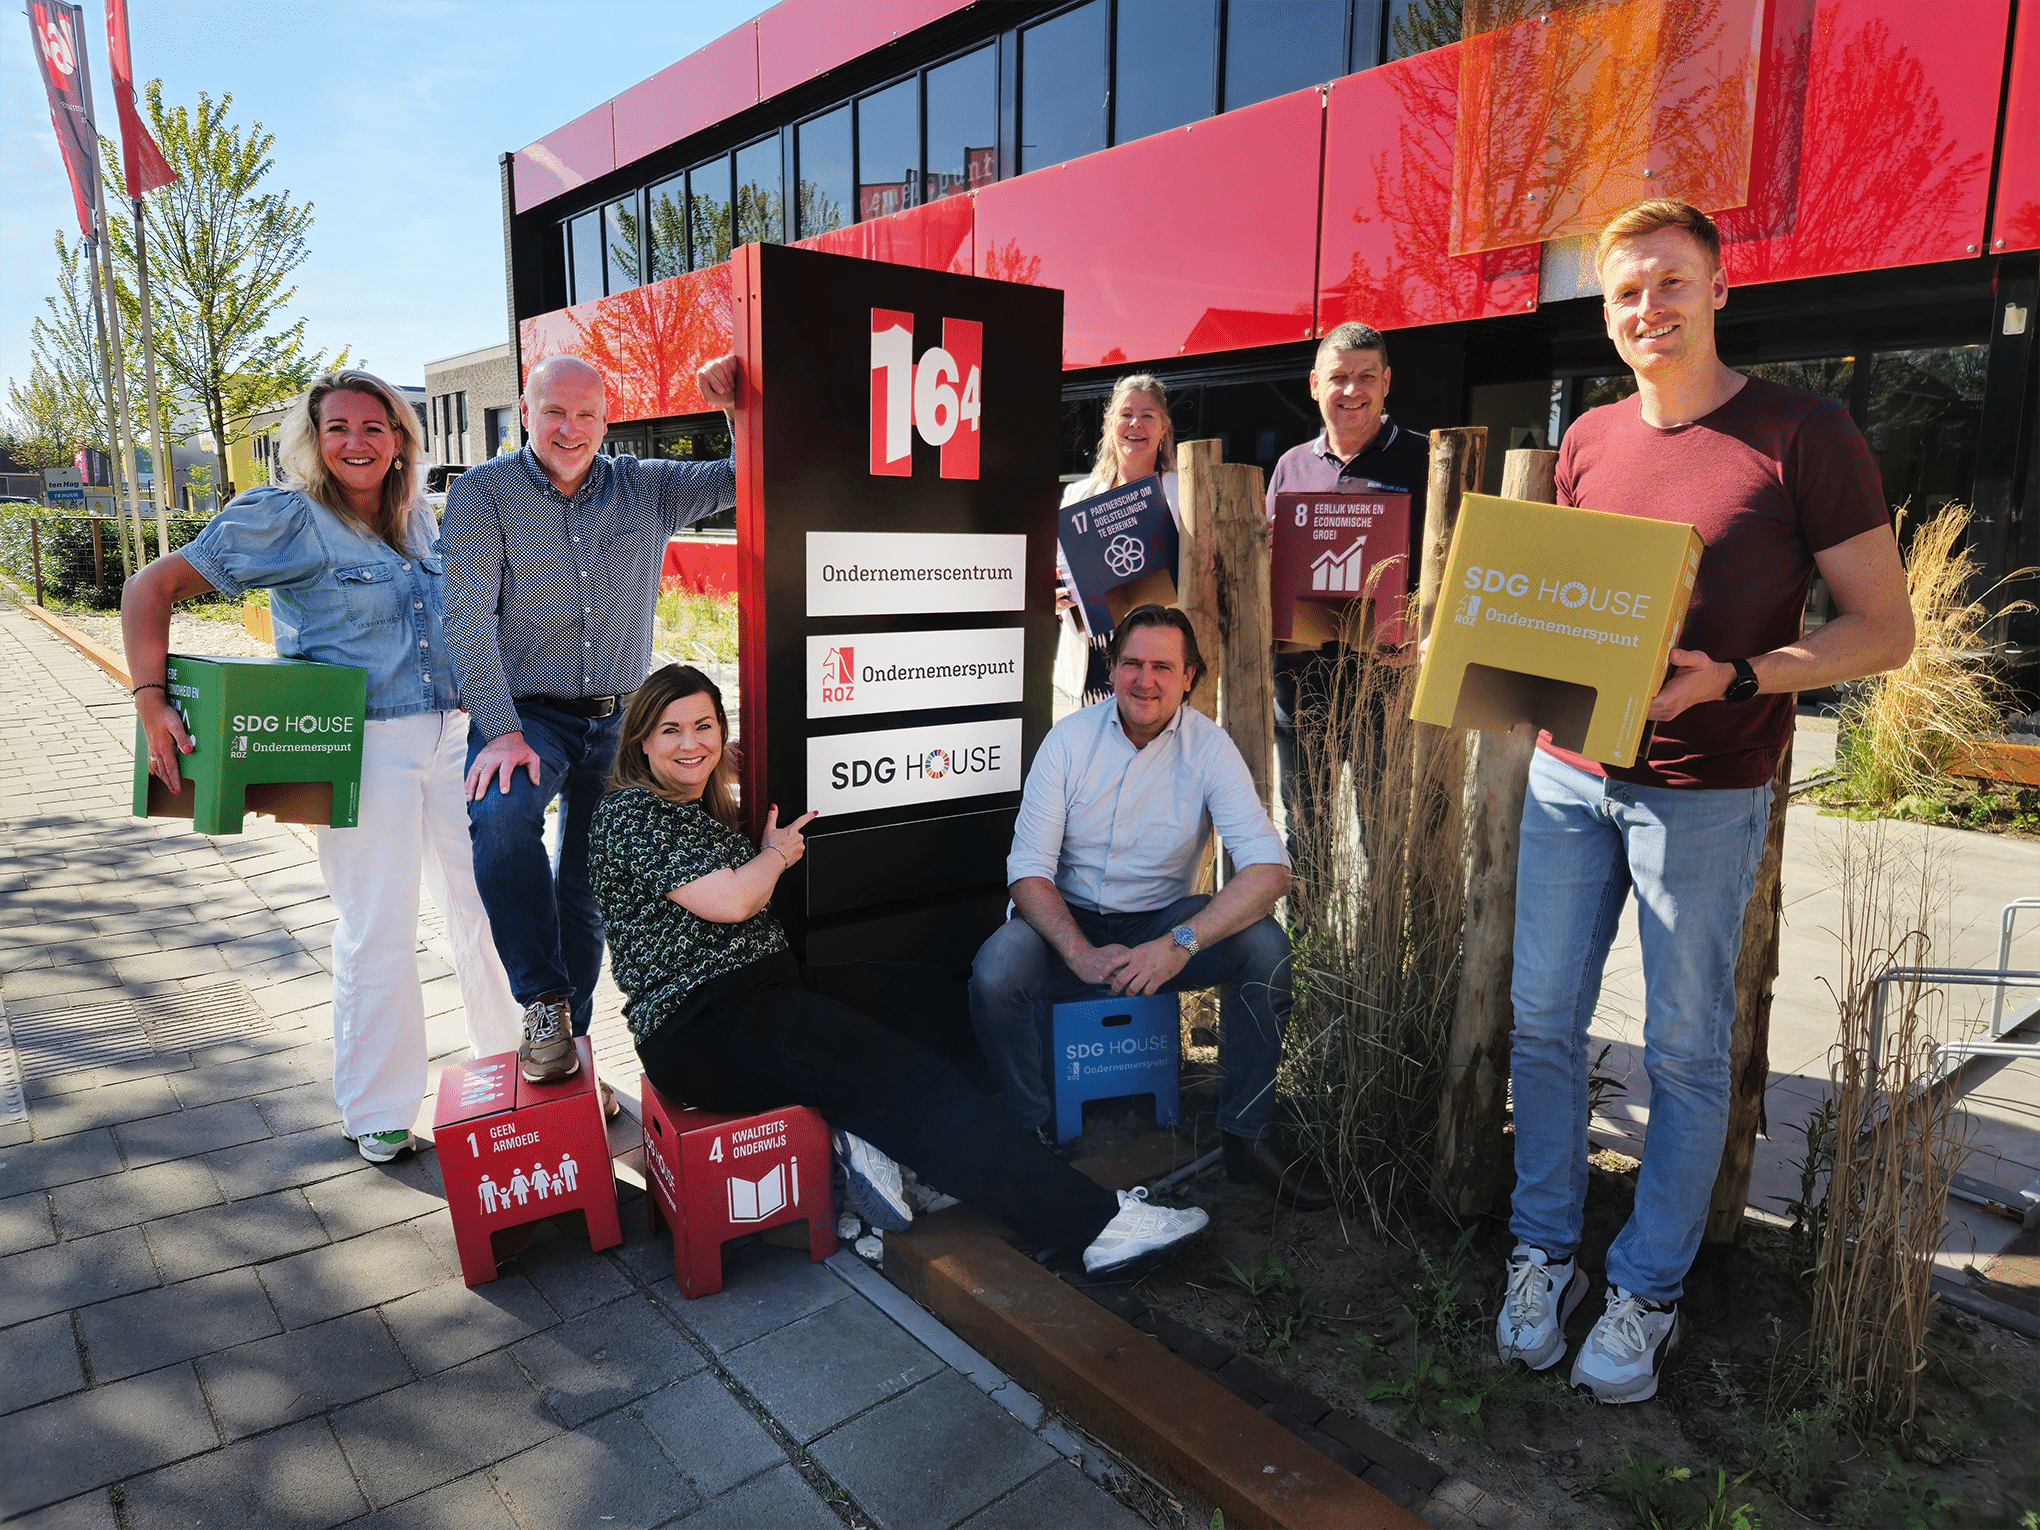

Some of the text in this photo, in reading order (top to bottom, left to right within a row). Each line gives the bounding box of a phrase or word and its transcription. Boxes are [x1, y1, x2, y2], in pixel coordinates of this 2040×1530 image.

[1090, 485, 1153, 518] PARTNERSCHAP OM
[1314, 503, 1384, 516] EERLIJK WERK EN
[1070, 511, 1089, 535] 17
[1093, 501, 1148, 529] DOELSTELLINGEN
[1294, 503, 1308, 528] 8
[1313, 515, 1373, 528] ECONOMISCHE
[1098, 518, 1138, 539] TE BEREIKEN
[1313, 528, 1337, 541] GROEI
[822, 563, 1013, 583] Ondernemerscentrum
[1463, 566, 1652, 620] SDG HOUSE
[1454, 614, 1476, 627] ROZ
[1485, 607, 1640, 648] Ondernemerspunt
[862, 658, 1015, 684] Ondernemerspunt
[822, 686, 855, 703] ROZ
[232, 714, 354, 734] SDG HOUSE
[252, 741, 352, 754] Ondernemerspunt
[831, 745, 1001, 791] SDG HOUSE
[1065, 1034, 1168, 1059] SDG HOUSE
[489, 1122, 516, 1138] GEEN
[493, 1131, 541, 1153] ARMOEDE
[731, 1119, 788, 1145] KWALITEITS-
[466, 1132, 480, 1158] 1
[708, 1136, 724, 1164] 4
[732, 1135, 787, 1159] ONDERWIJS
